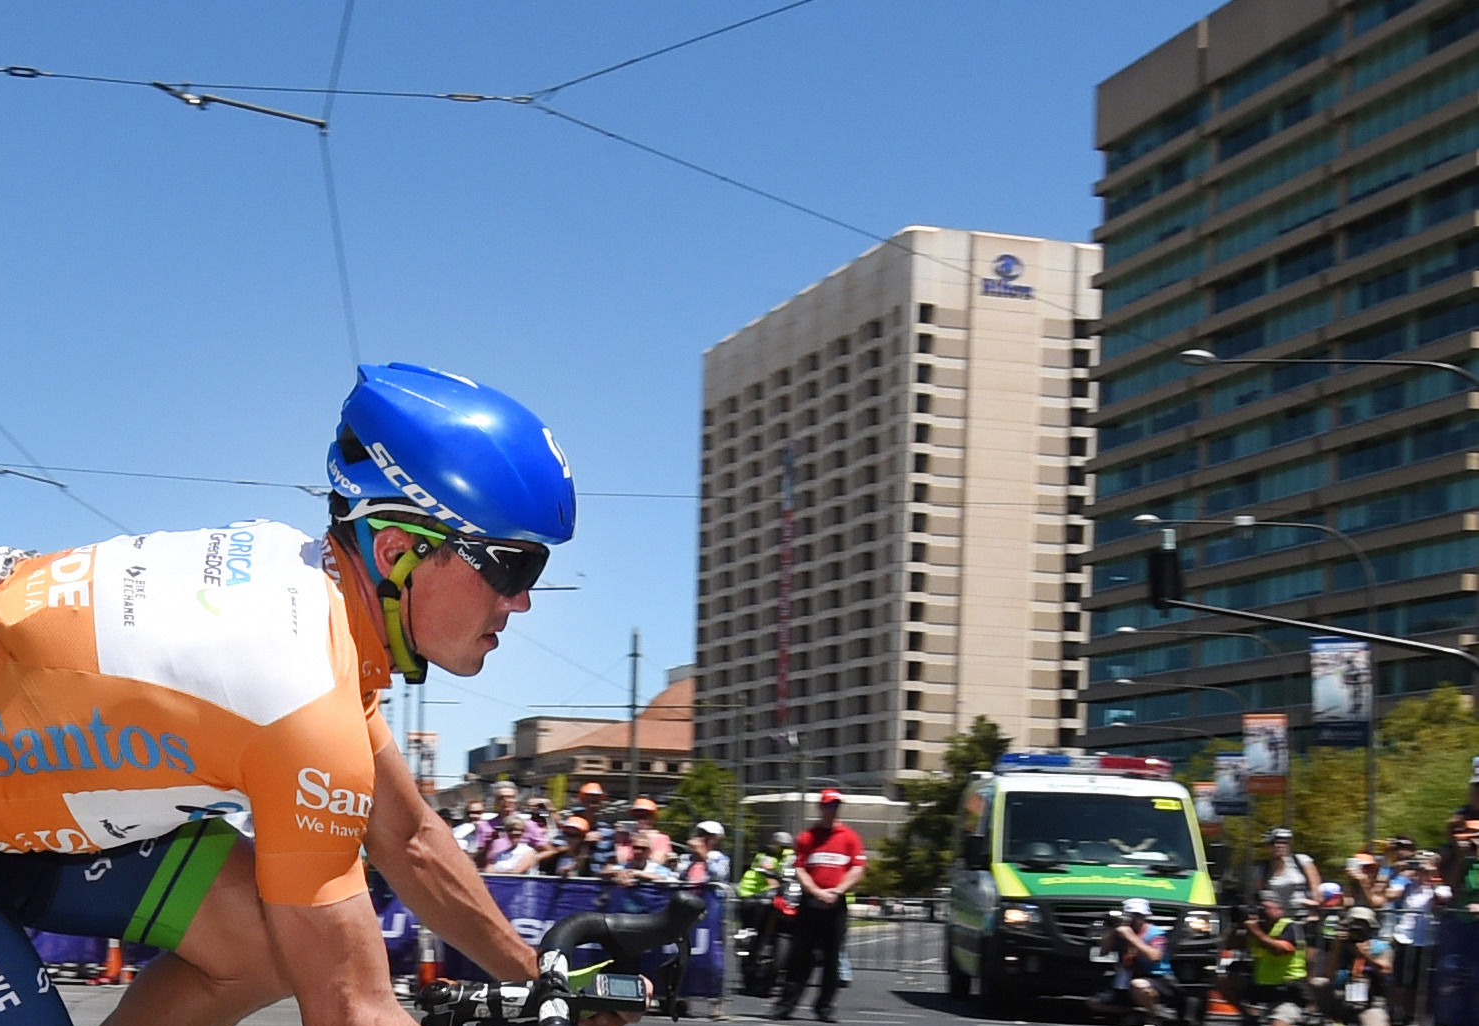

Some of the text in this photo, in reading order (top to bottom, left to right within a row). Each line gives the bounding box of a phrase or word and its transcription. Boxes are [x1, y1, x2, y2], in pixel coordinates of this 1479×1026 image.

[329, 458, 362, 496] Jayco
[365, 442, 486, 535] SCOTT
[46, 546, 93, 609] DE
[225, 531, 255, 587] ORICA
[123, 577, 135, 628] EXCHANGE
[296, 767, 374, 818] San
[295, 813, 360, 837] We have
